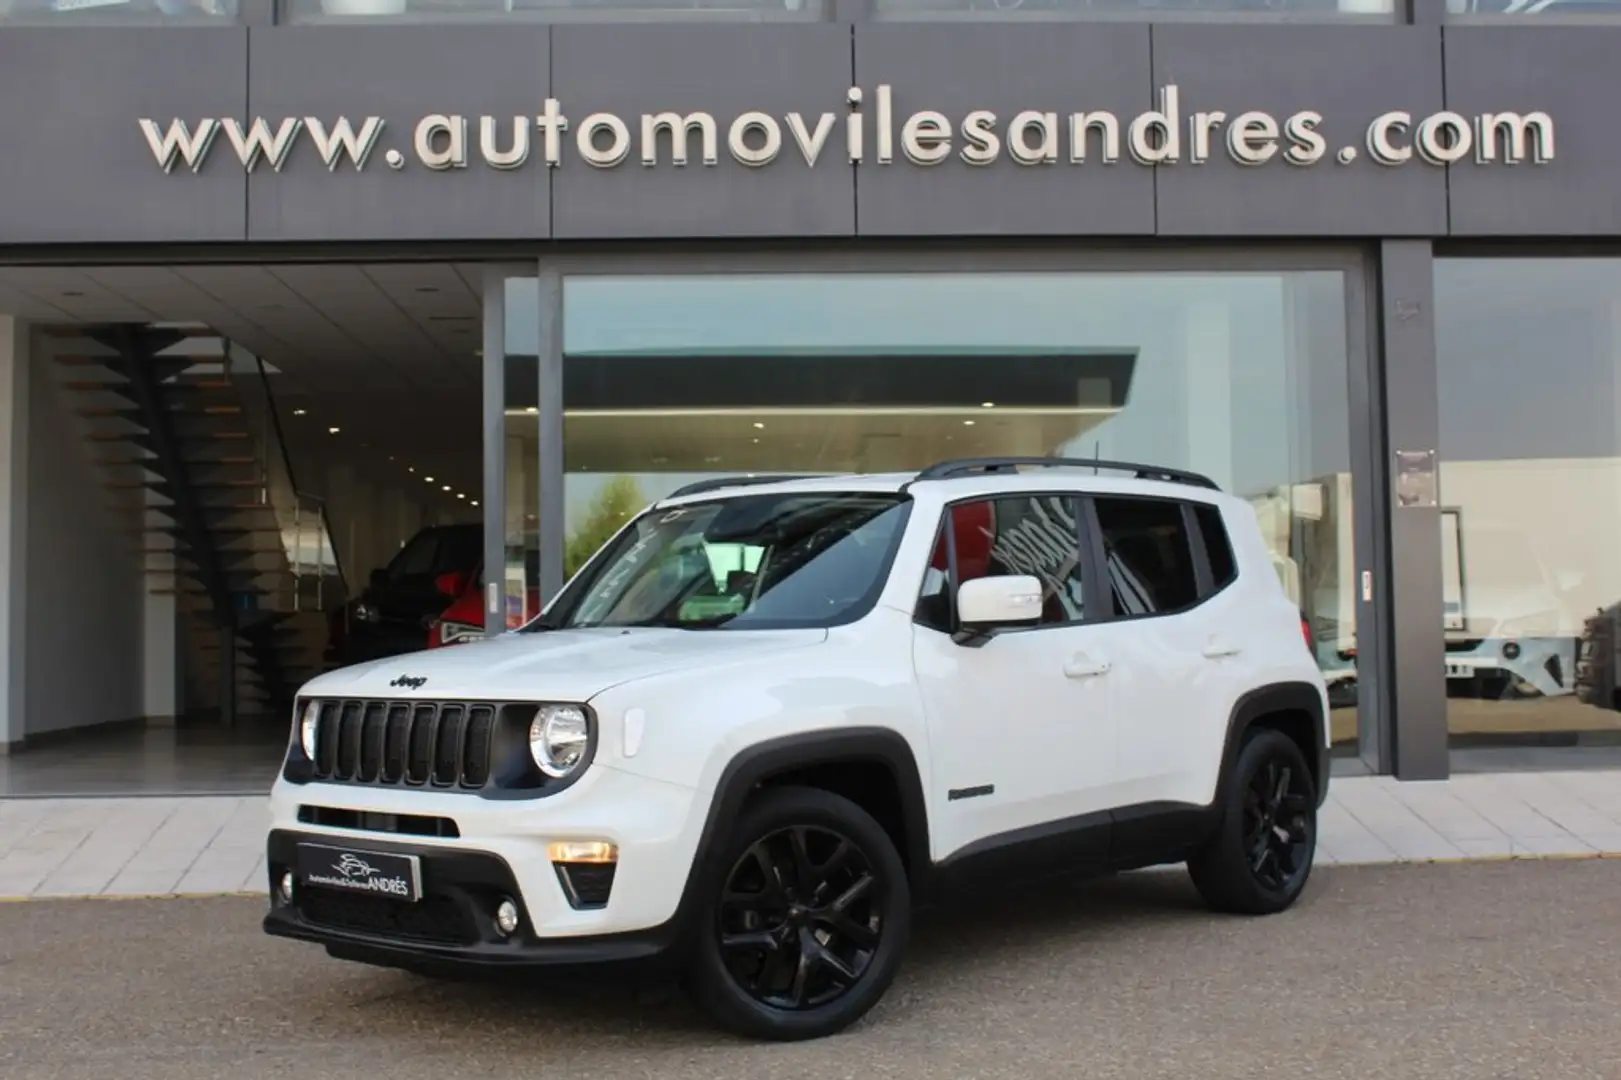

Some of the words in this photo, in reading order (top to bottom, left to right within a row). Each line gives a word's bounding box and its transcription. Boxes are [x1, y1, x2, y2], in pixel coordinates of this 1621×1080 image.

[138, 84, 1555, 173] www.automovilesandres.com
[390, 674, 428, 691] Jeep
[367, 876, 409, 896] ANDRÉS
